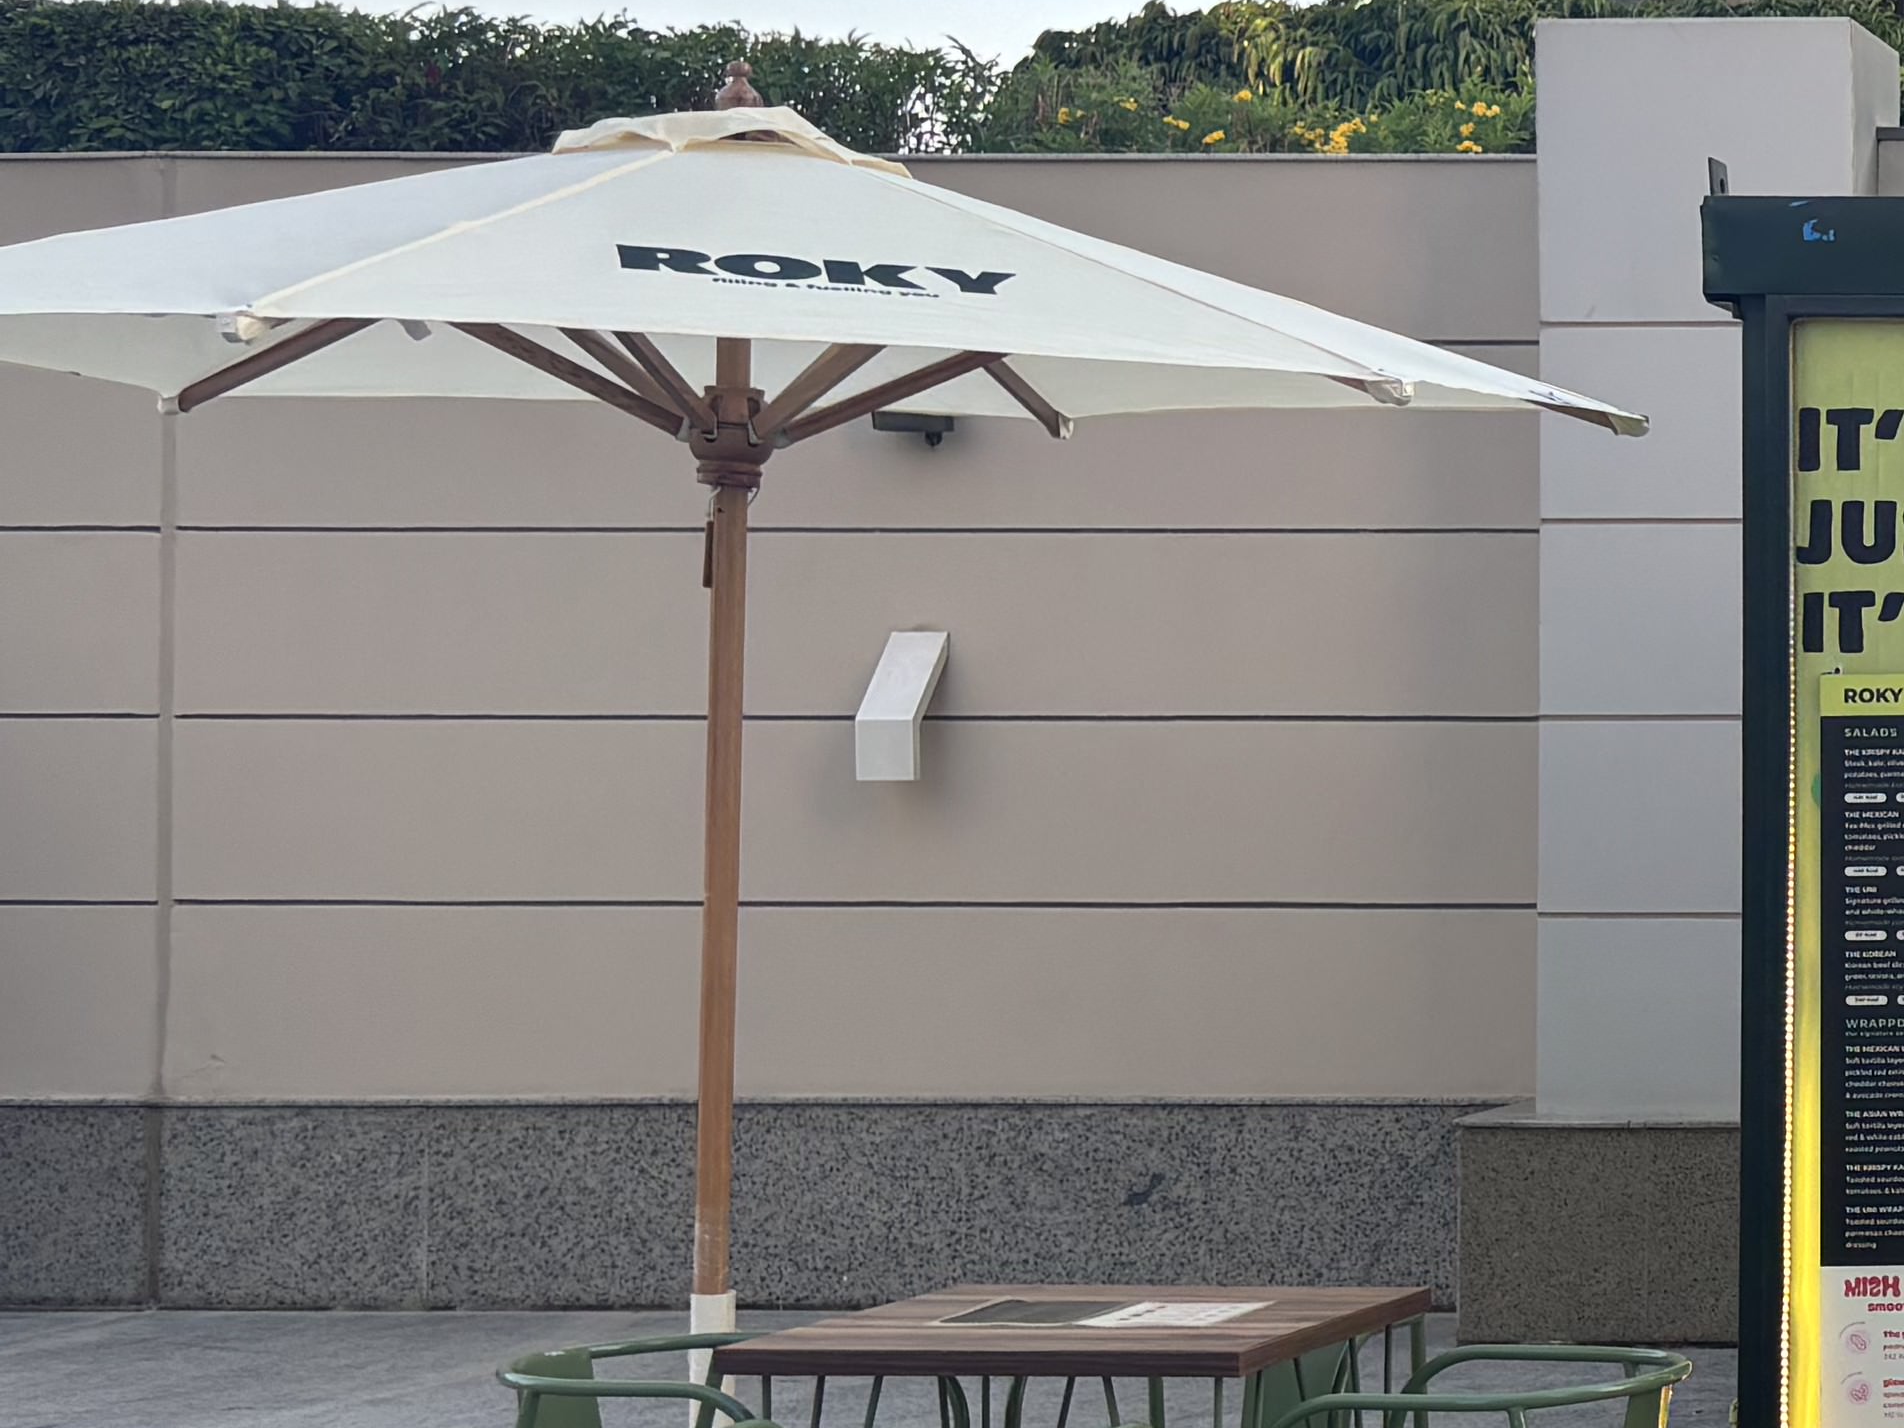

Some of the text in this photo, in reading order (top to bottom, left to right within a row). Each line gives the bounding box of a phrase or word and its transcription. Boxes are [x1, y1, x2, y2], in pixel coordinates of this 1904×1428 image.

[616, 244, 1017, 295] ROKY
[1843, 687, 1904, 704] ROKY
[1844, 728, 1897, 737] SALADS
[1844, 1276, 1900, 1297] MISH
